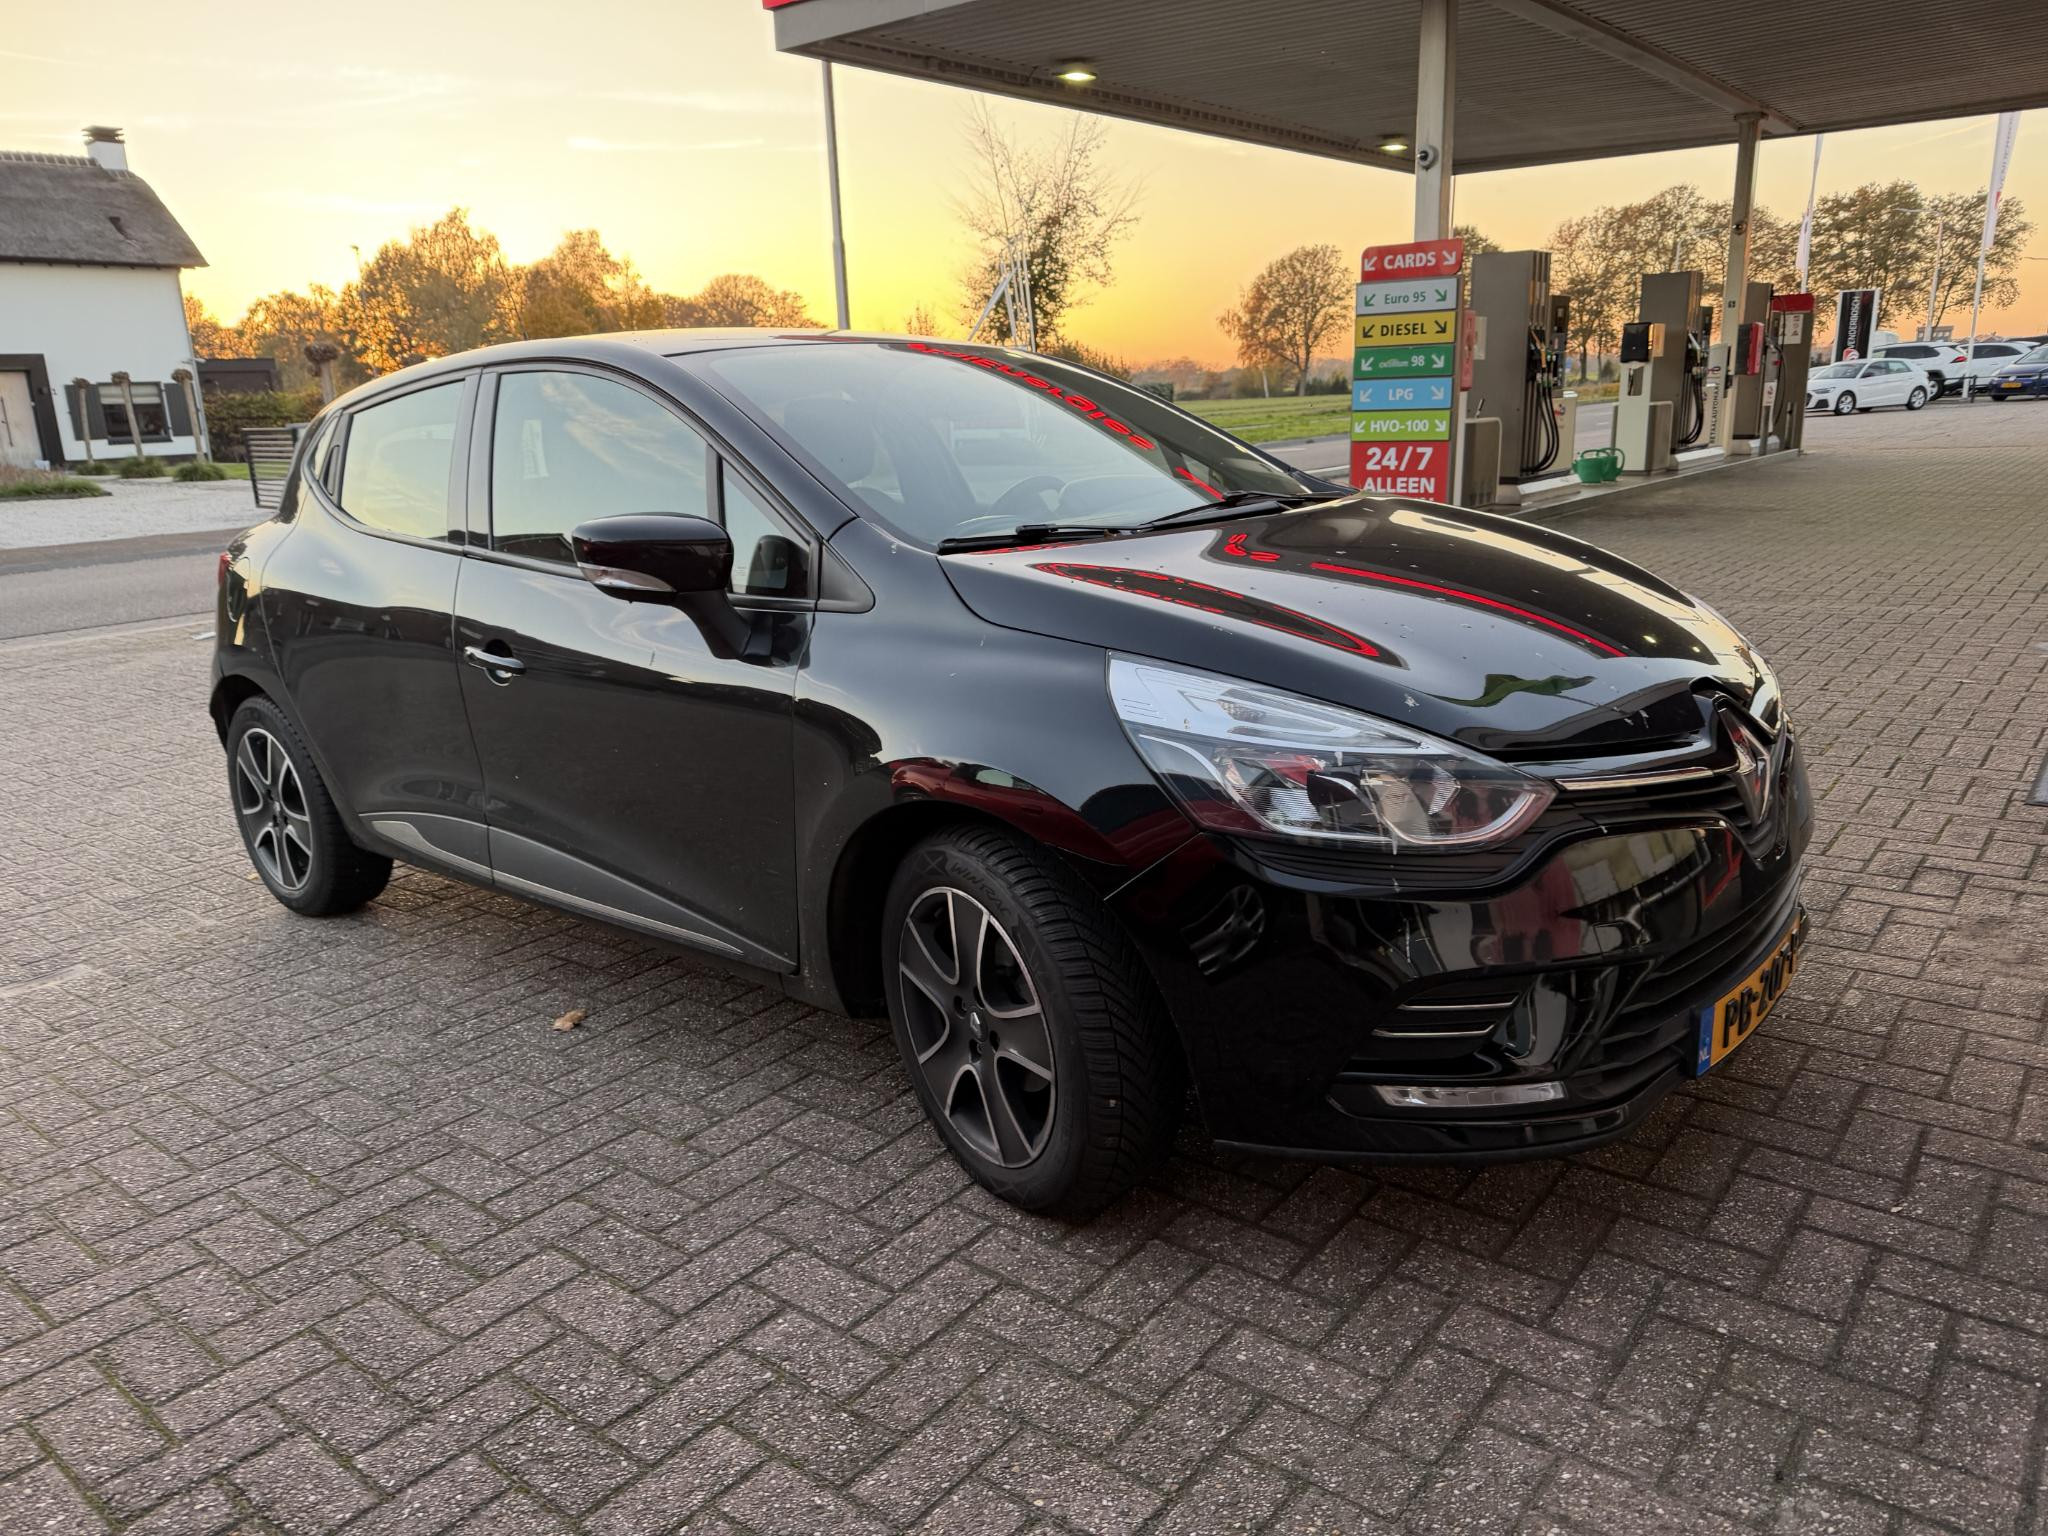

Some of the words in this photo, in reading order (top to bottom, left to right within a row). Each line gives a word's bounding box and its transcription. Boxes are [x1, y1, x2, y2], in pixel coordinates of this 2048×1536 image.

[1383, 251, 1436, 270] CARDS
[1384, 293, 1410, 305] Euro
[1412, 291, 1427, 303] 95
[1380, 322, 1427, 337] DIESEL
[1411, 355, 1425, 367] 98
[1388, 388, 1414, 401] LPG
[1369, 419, 1430, 433] HVO-100
[1365, 446, 1434, 472] 24/7
[1362, 477, 1436, 494] ALLEEN
